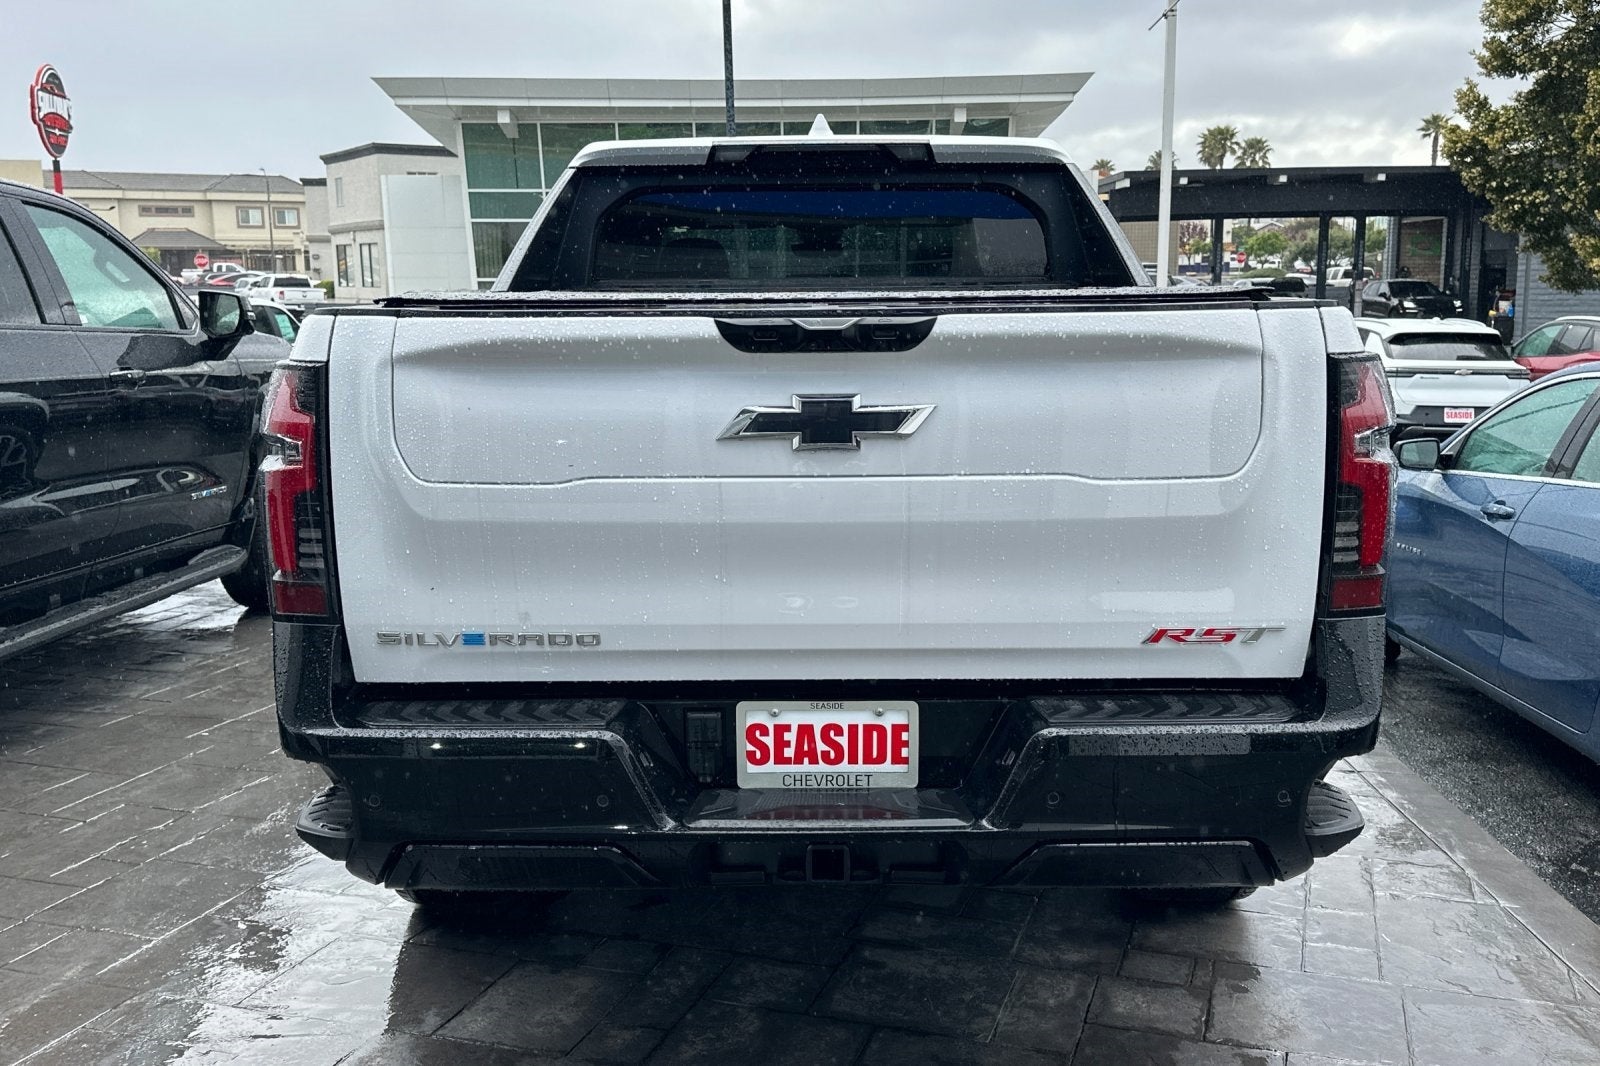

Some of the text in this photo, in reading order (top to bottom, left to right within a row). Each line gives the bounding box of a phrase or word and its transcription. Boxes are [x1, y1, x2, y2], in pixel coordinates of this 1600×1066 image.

[1446, 411, 1473, 419] SEASIDE
[376, 631, 602, 647] SILVERADO
[1140, 626, 1287, 645] RST
[810, 702, 845, 710] SEASIDE
[745, 723, 910, 766] SEASIDE
[782, 774, 873, 787] CHEVROLET
